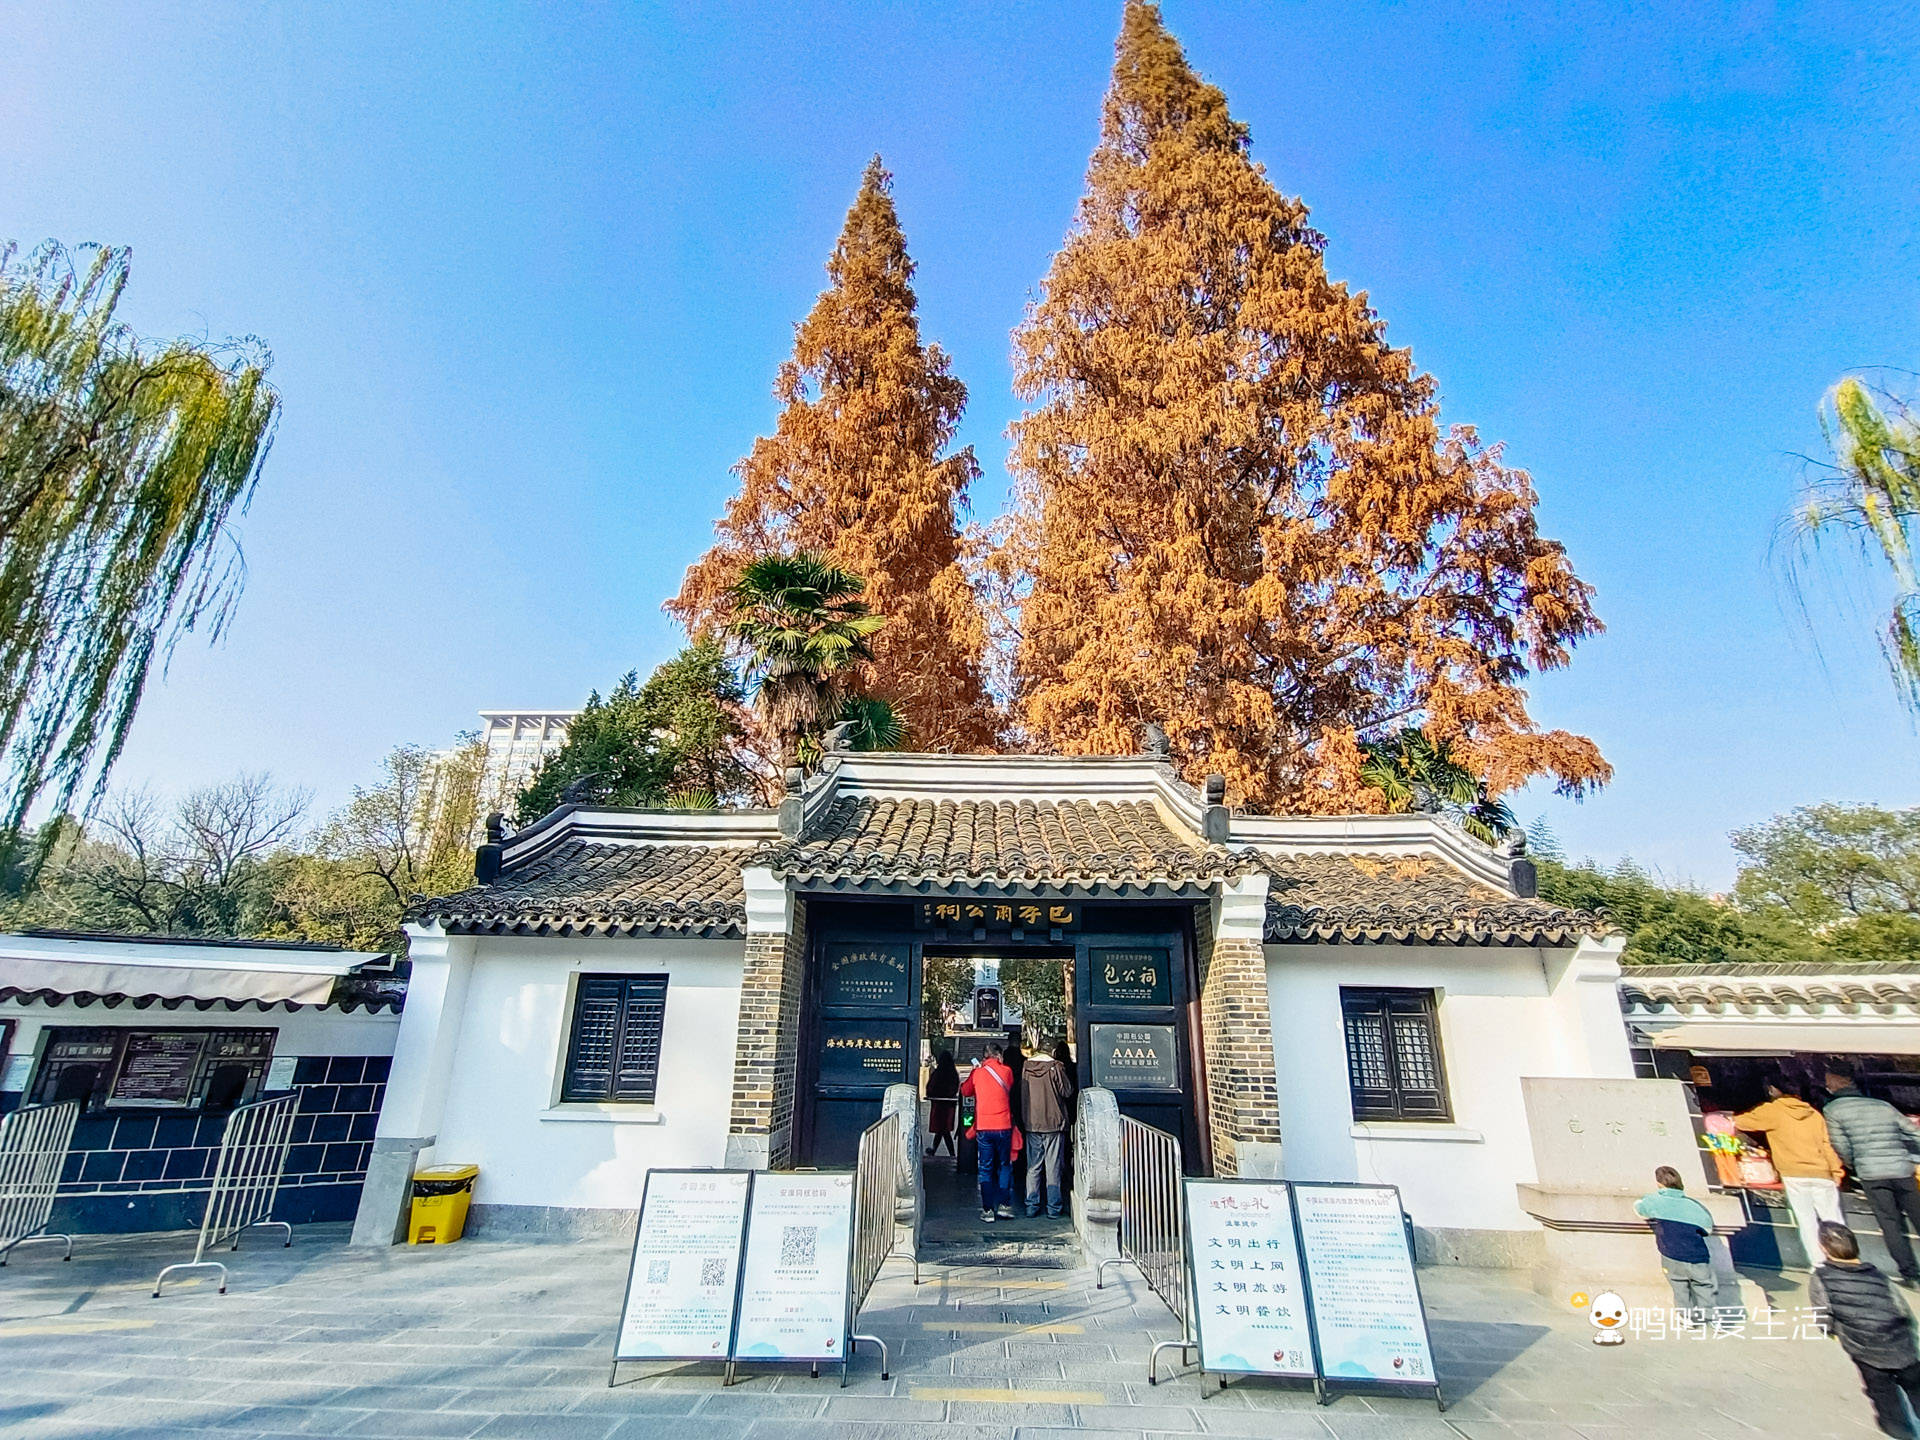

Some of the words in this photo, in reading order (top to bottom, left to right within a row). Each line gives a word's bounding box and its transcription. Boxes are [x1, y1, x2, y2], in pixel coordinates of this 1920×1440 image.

[1104, 963, 1157, 987] 包公祠
[1112, 1048, 1157, 1059] AAAA
[1208, 1237, 1281, 1249] 文明出行
[1210, 1259, 1284, 1271] 文明上网
[1213, 1281, 1288, 1293] 文明旅游
[1215, 1304, 1292, 1317] 文明餐饮
